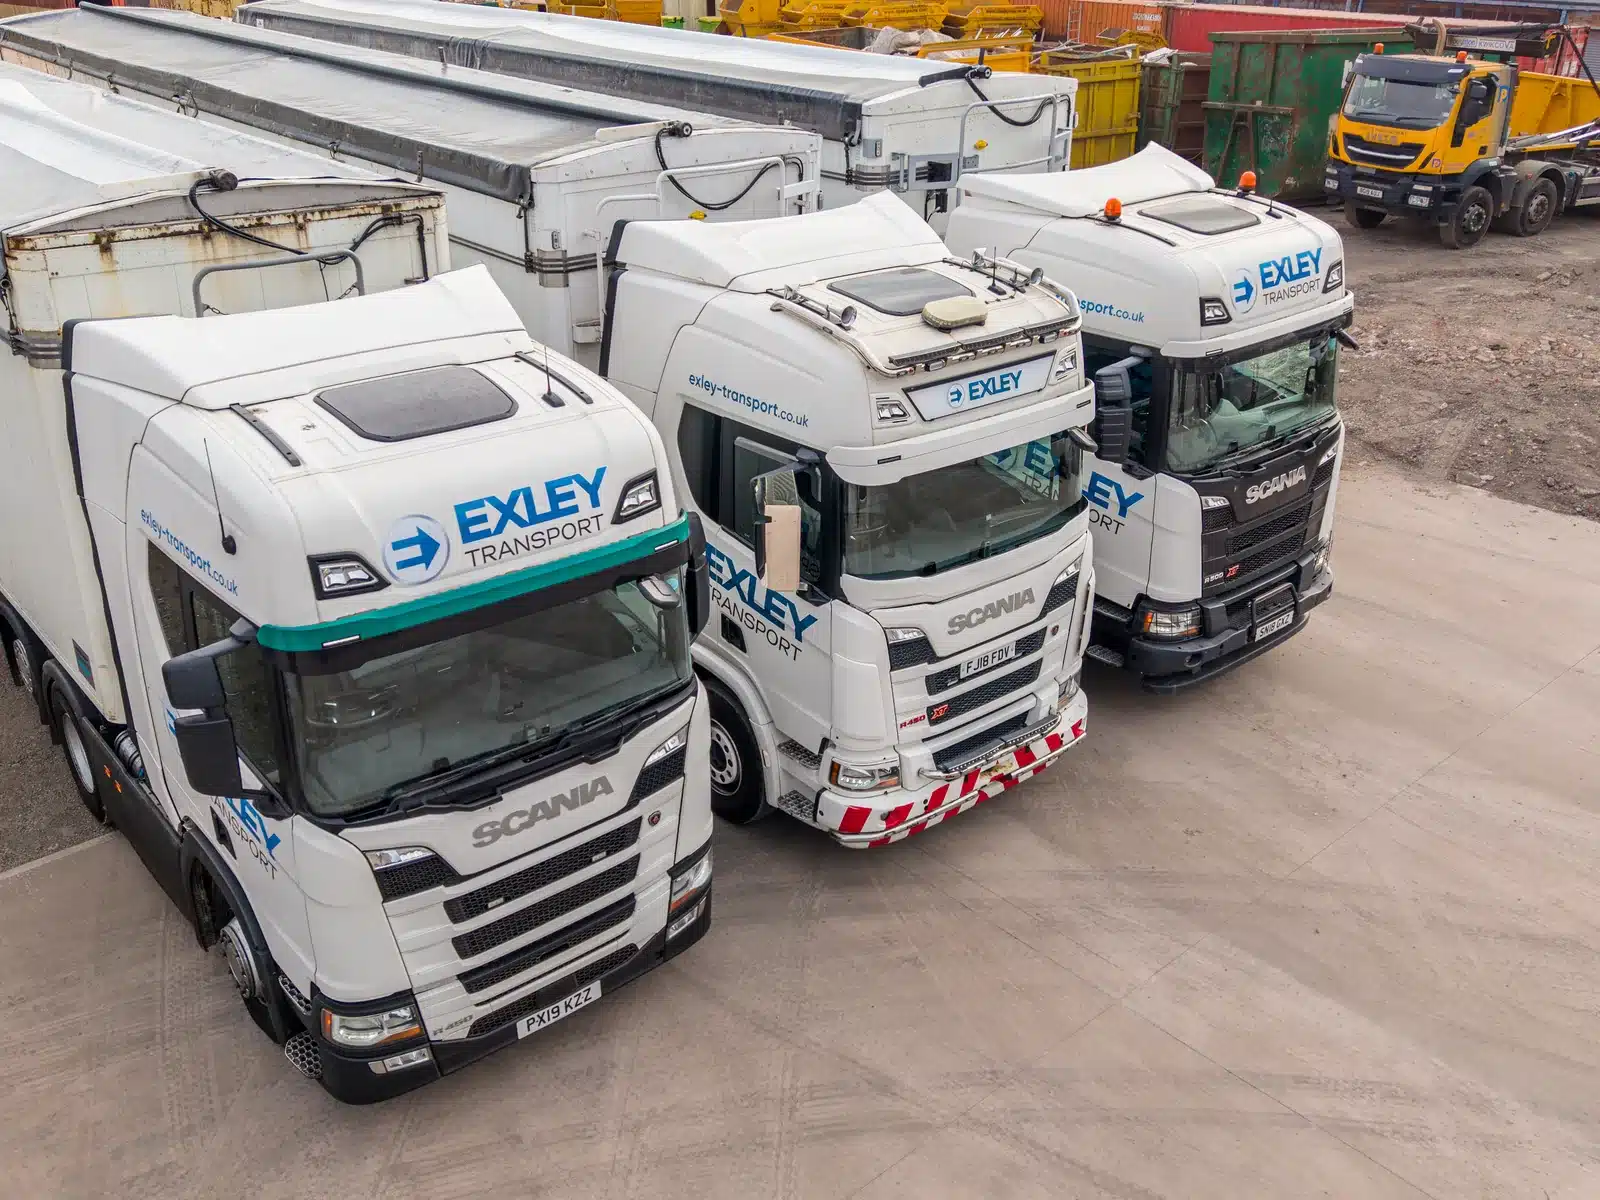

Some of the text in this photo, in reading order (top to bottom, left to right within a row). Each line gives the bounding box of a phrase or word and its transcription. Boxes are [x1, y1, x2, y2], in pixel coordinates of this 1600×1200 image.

[1259, 247, 1322, 289] EXLEY
[1263, 278, 1320, 305] TRANSPORT
[1078, 299, 1144, 323] sport.co.uk
[689, 373, 808, 427] exley-transport.co.uk
[968, 369, 1022, 401] EXLEY
[453, 465, 608, 544] EXLEY
[1246, 465, 1307, 504] SCANIA
[140, 509, 238, 597] exley-transport.co.uk
[465, 514, 603, 567] TRANSPORT
[706, 541, 818, 643] EXLEY
[946, 587, 1035, 635] SCANIA
[709, 585, 803, 662] RANSPORT
[966, 646, 1011, 674] FJ18 FDV
[472, 775, 614, 848] SCANIA
[526, 987, 593, 1032] PX19 KZZ
